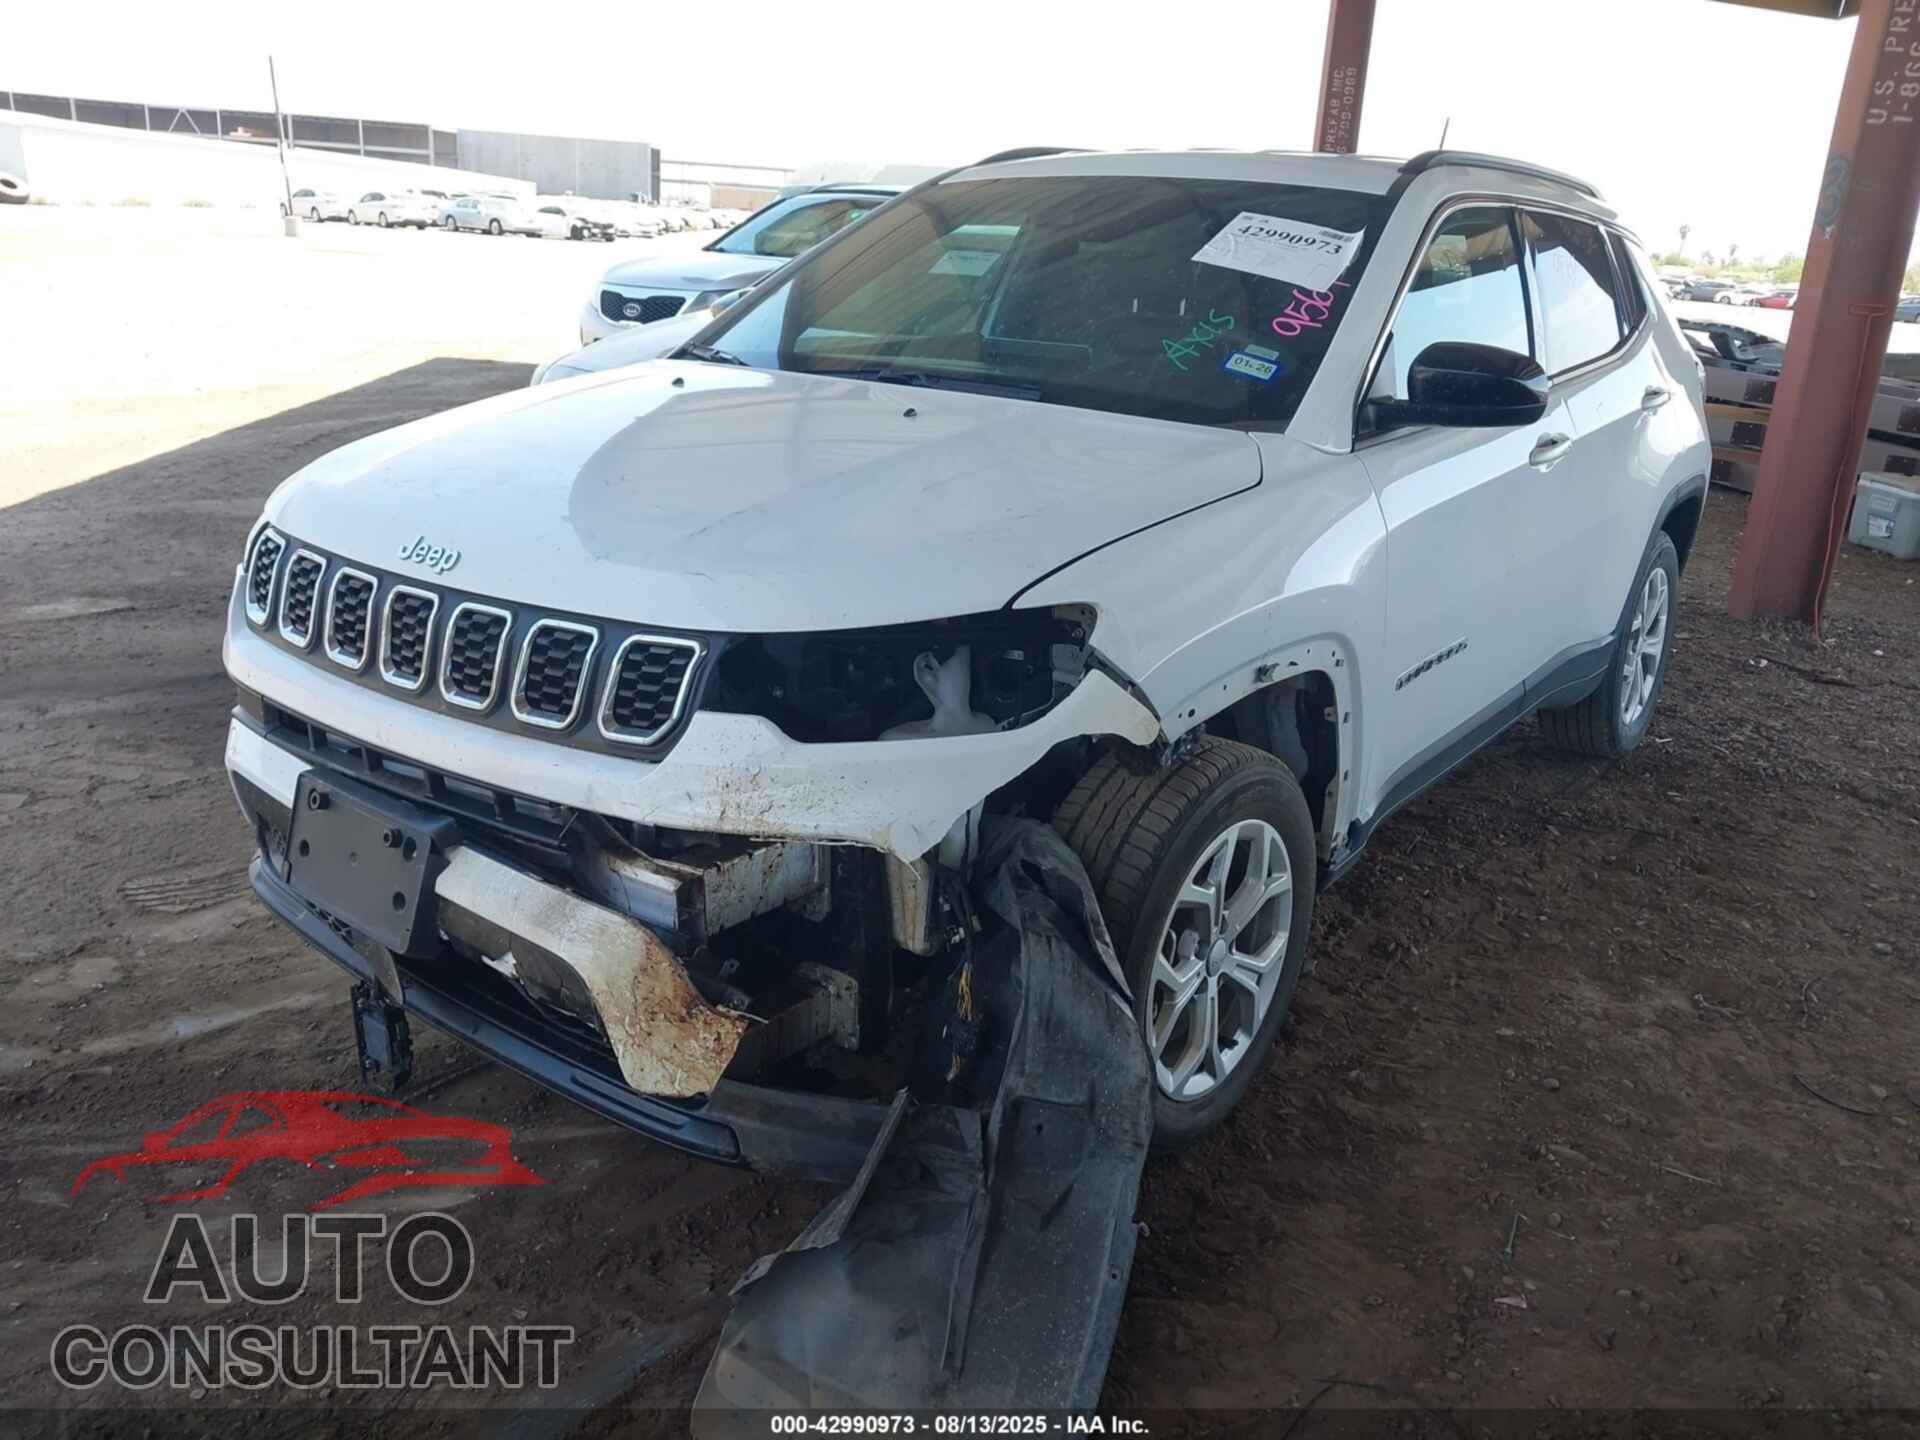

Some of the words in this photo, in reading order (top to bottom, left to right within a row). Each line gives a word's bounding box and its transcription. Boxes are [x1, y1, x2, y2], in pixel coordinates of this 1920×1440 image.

[1866, 72, 1899, 124] U.S.
[1237, 223, 1343, 256] 42990973
[398, 534, 462, 576] Jeep
